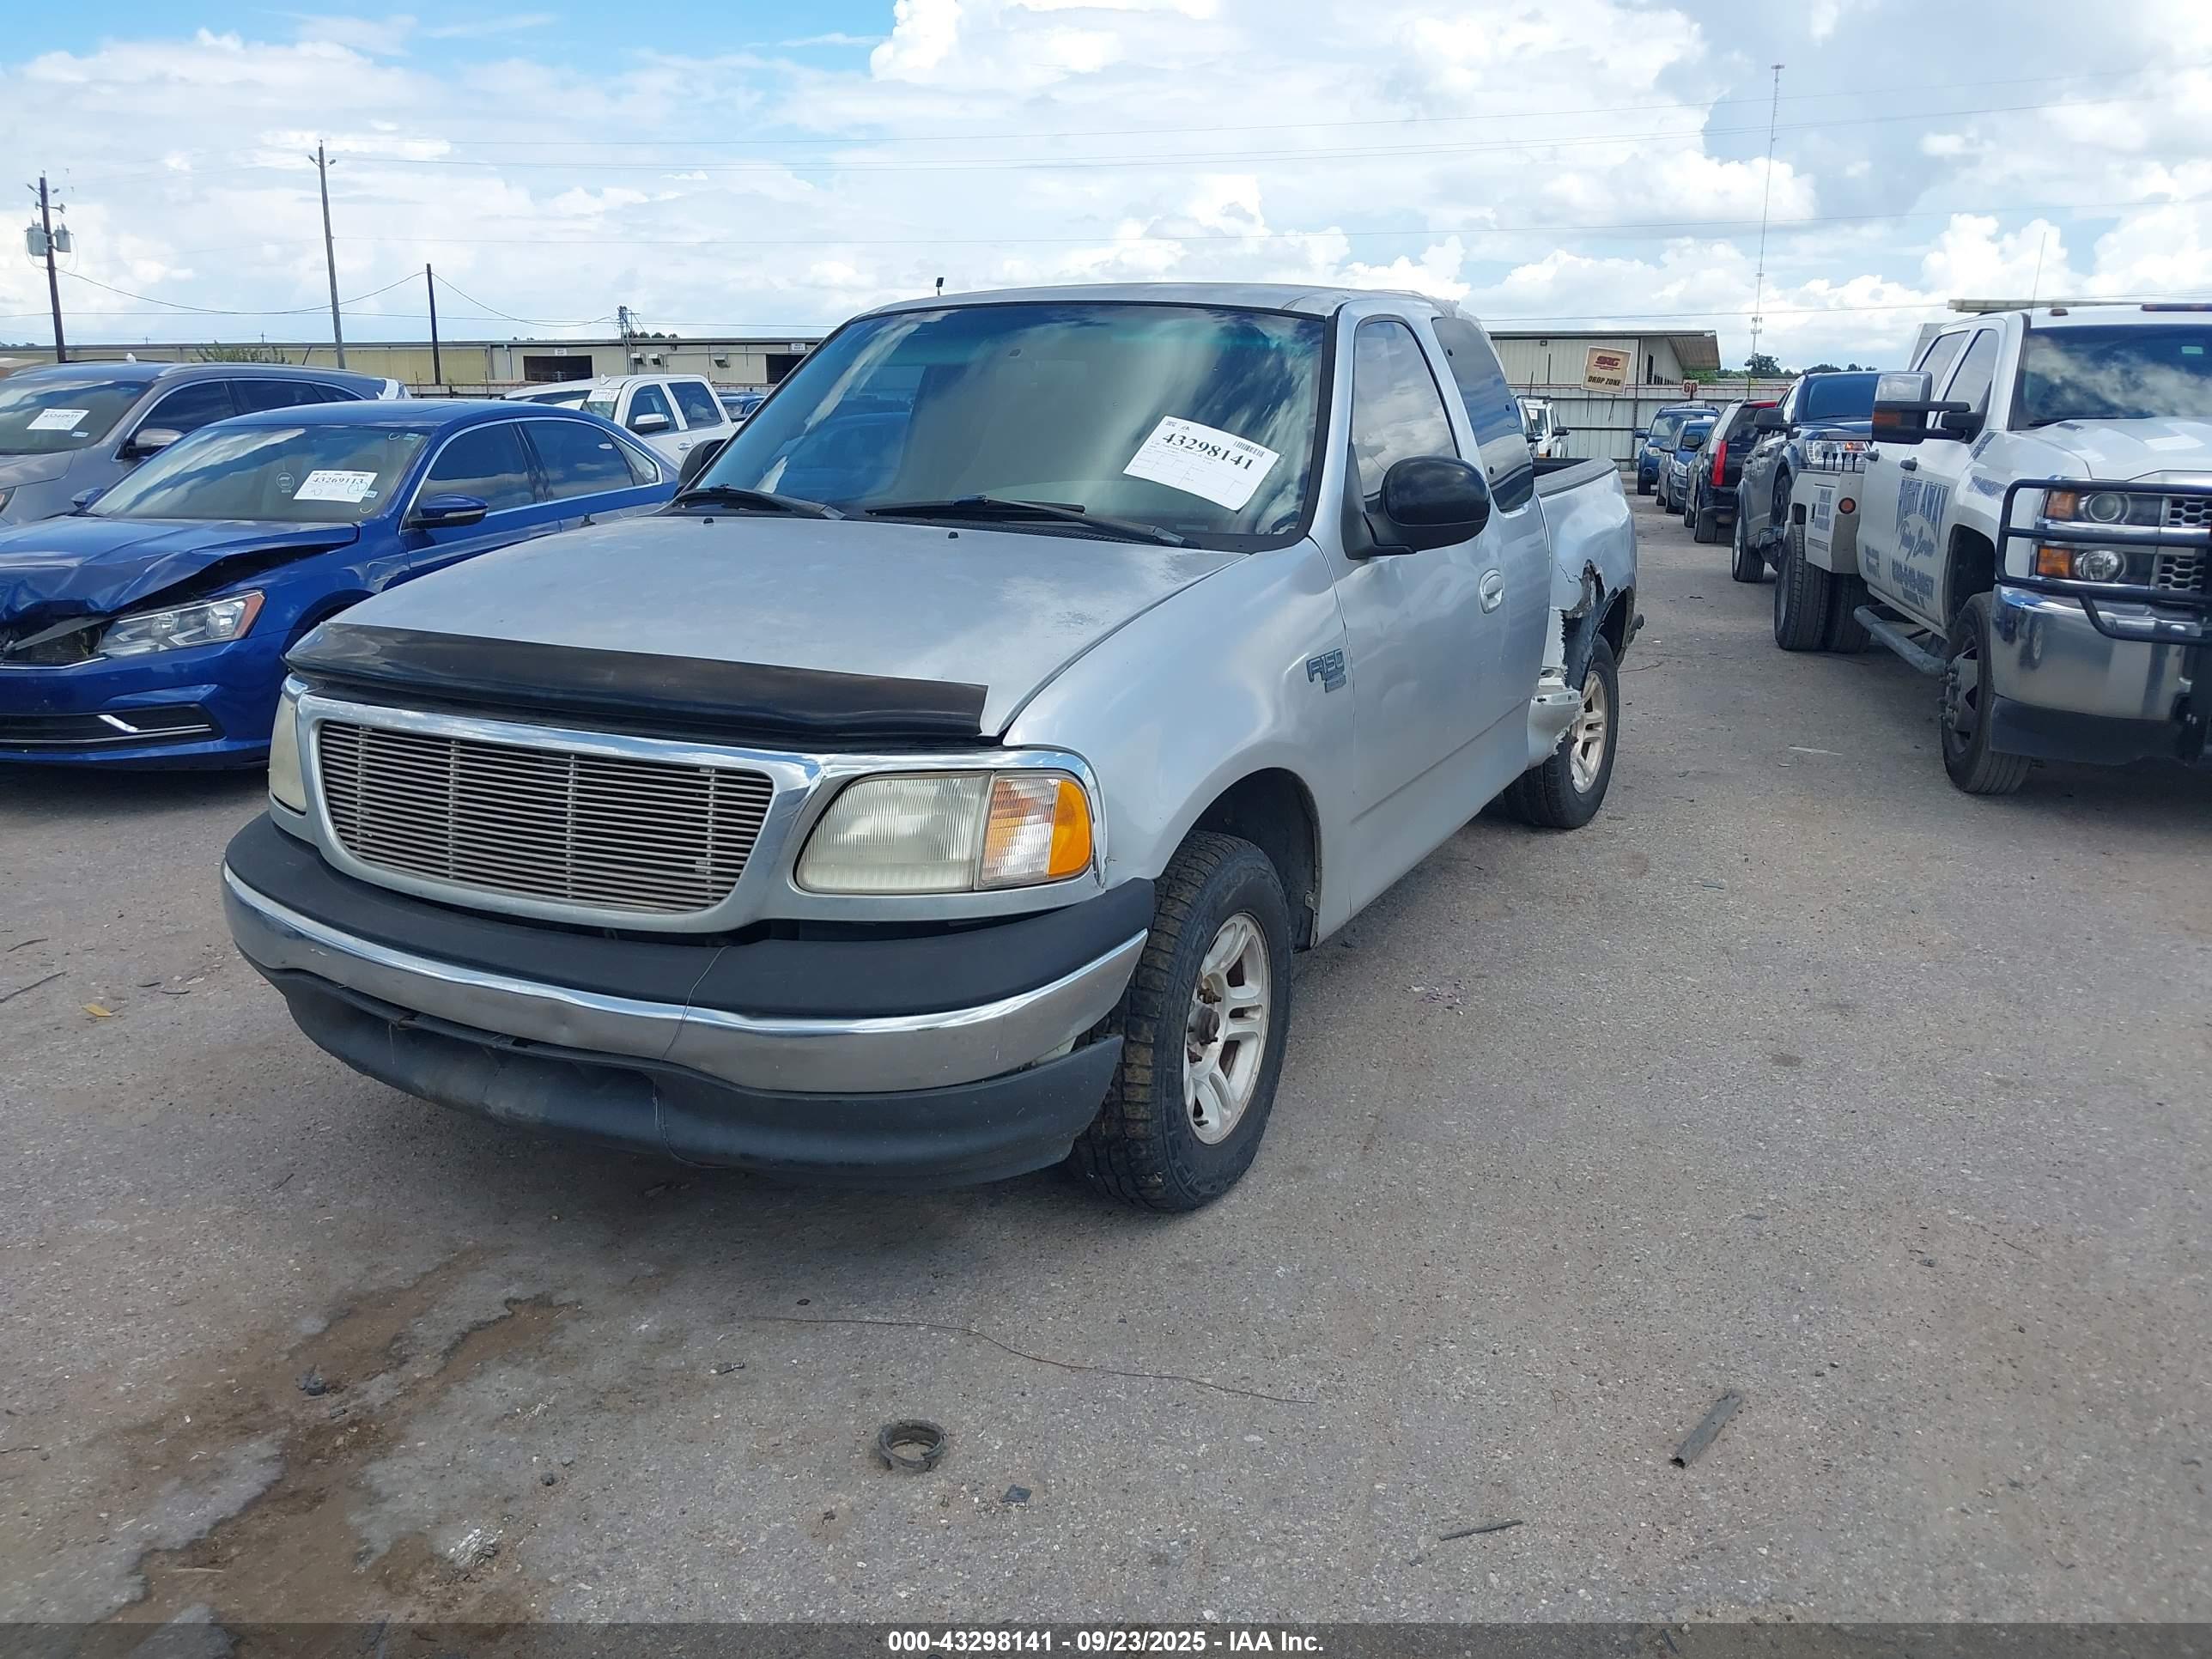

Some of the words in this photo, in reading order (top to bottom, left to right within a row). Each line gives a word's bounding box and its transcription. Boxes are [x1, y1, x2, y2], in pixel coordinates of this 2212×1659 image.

[1588, 375, 1605, 384] DROP
[1606, 377, 1621, 386] ZONE
[1162, 432, 1255, 471] 43298141
